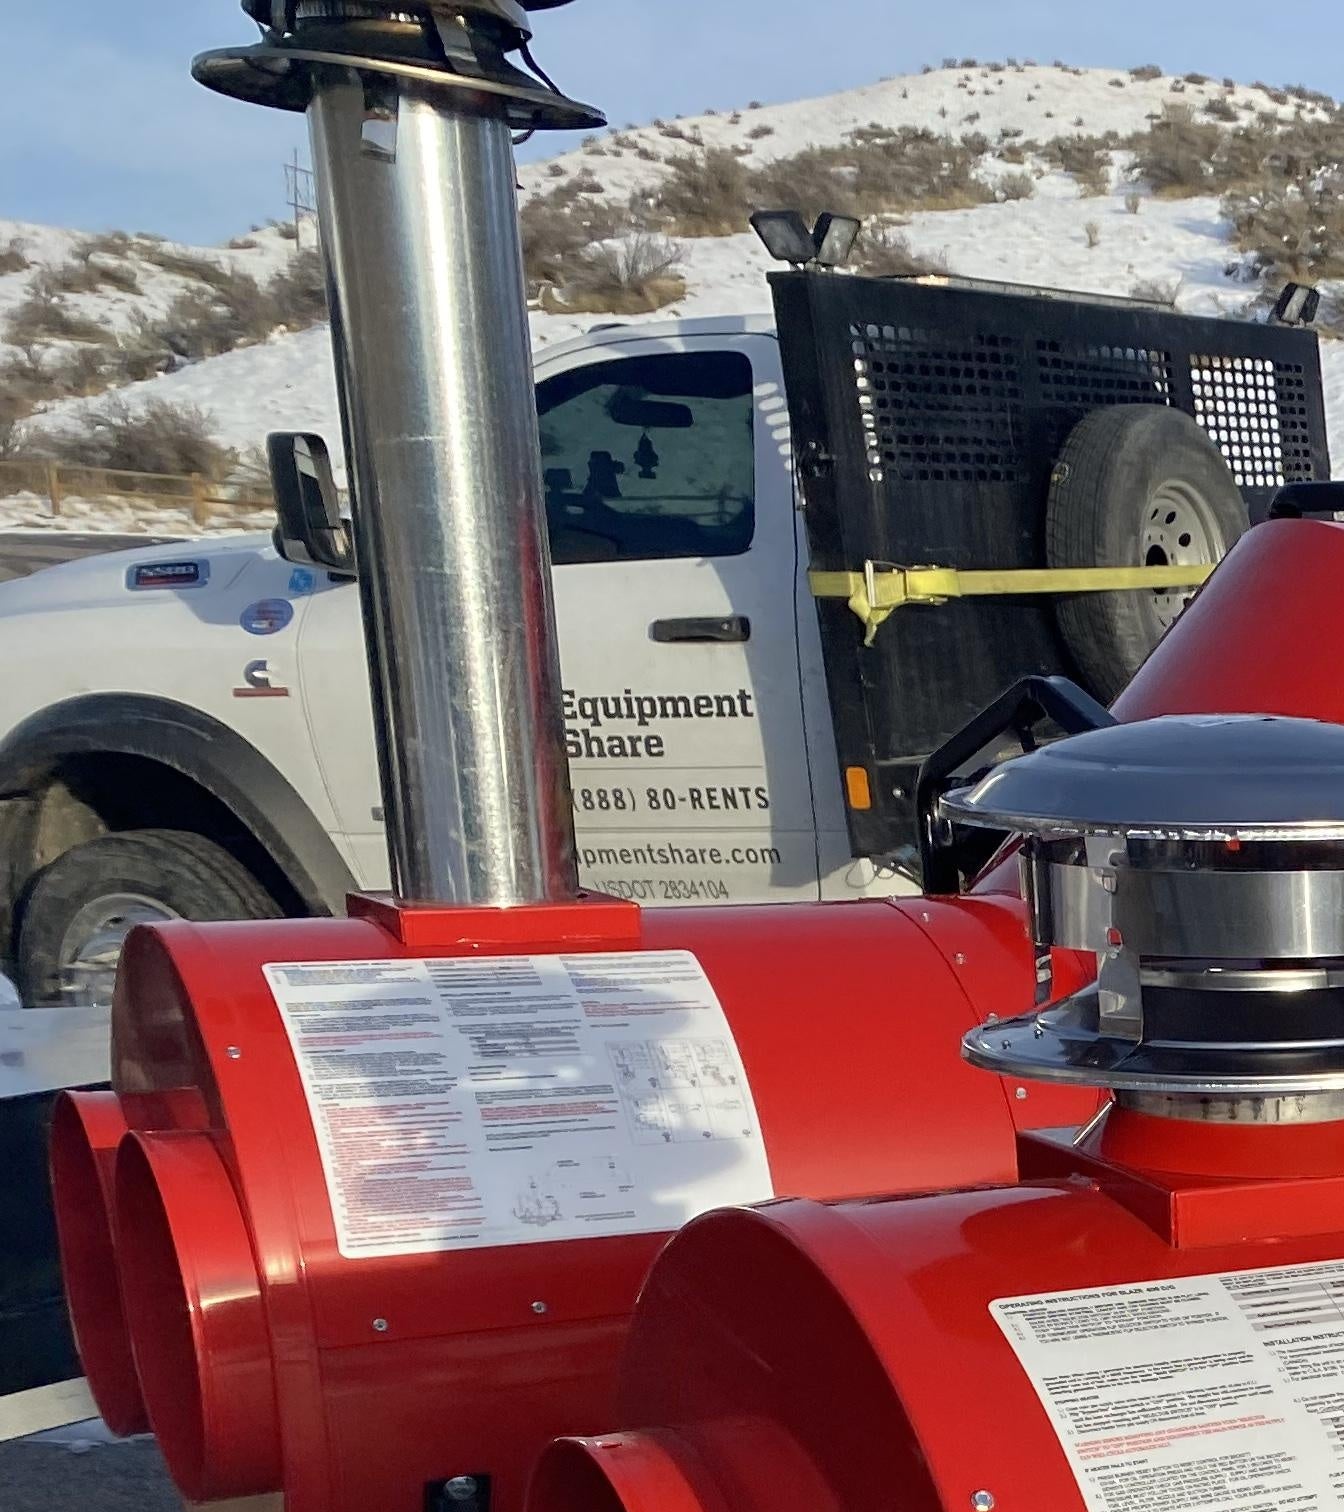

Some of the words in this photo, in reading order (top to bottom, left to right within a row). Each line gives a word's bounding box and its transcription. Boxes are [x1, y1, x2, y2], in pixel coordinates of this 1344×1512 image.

[562, 689, 754, 727] Equipment
[565, 728, 665, 758] Share
[571, 788, 637, 812] (888)
[646, 786, 770, 811] 80-RENTS
